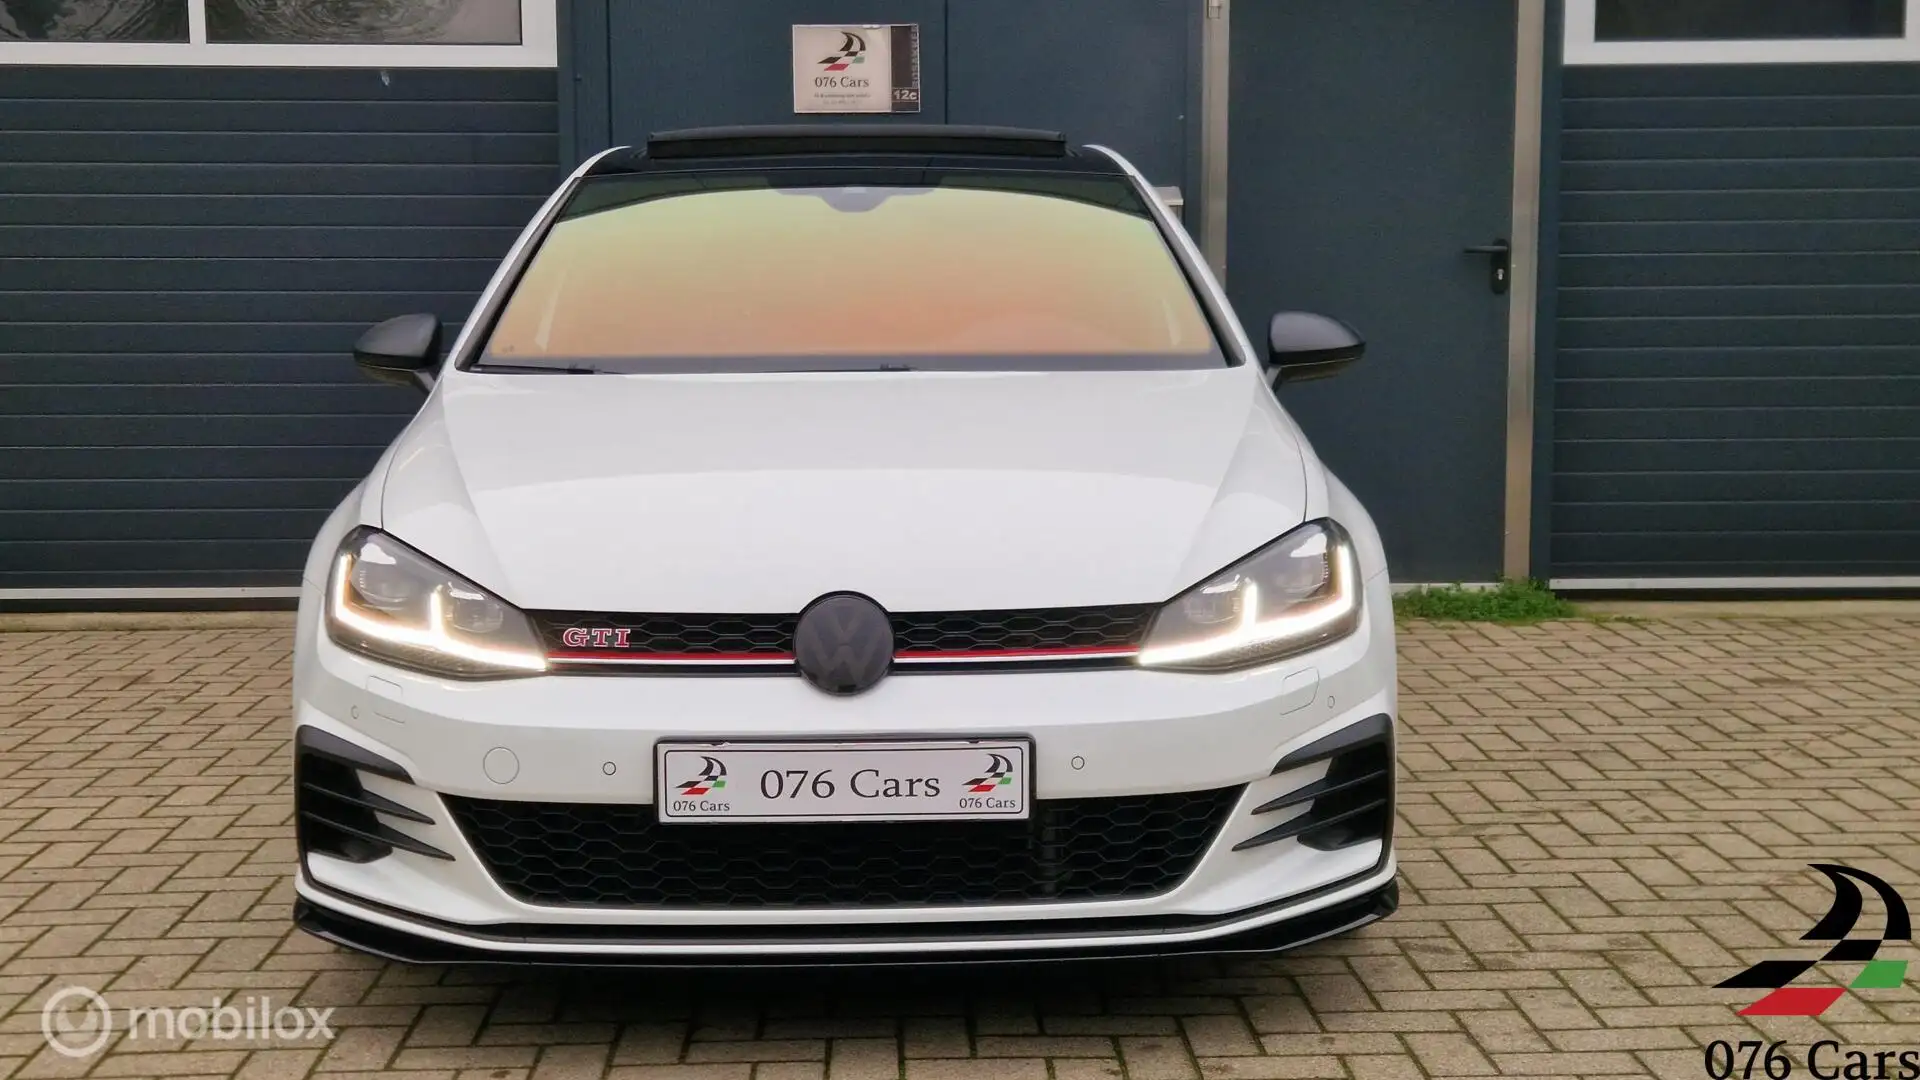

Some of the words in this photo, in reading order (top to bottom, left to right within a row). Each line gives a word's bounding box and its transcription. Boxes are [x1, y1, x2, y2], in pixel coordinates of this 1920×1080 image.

[815, 76, 837, 88] 076
[840, 76, 870, 88] Cars
[894, 90, 917, 100] 12c
[563, 627, 631, 647] GTI
[760, 769, 836, 799] 076
[850, 768, 941, 798] Cars
[672, 800, 697, 812] 076
[699, 800, 731, 812] Cars
[959, 797, 982, 809] 076
[986, 797, 1016, 809] Cars
